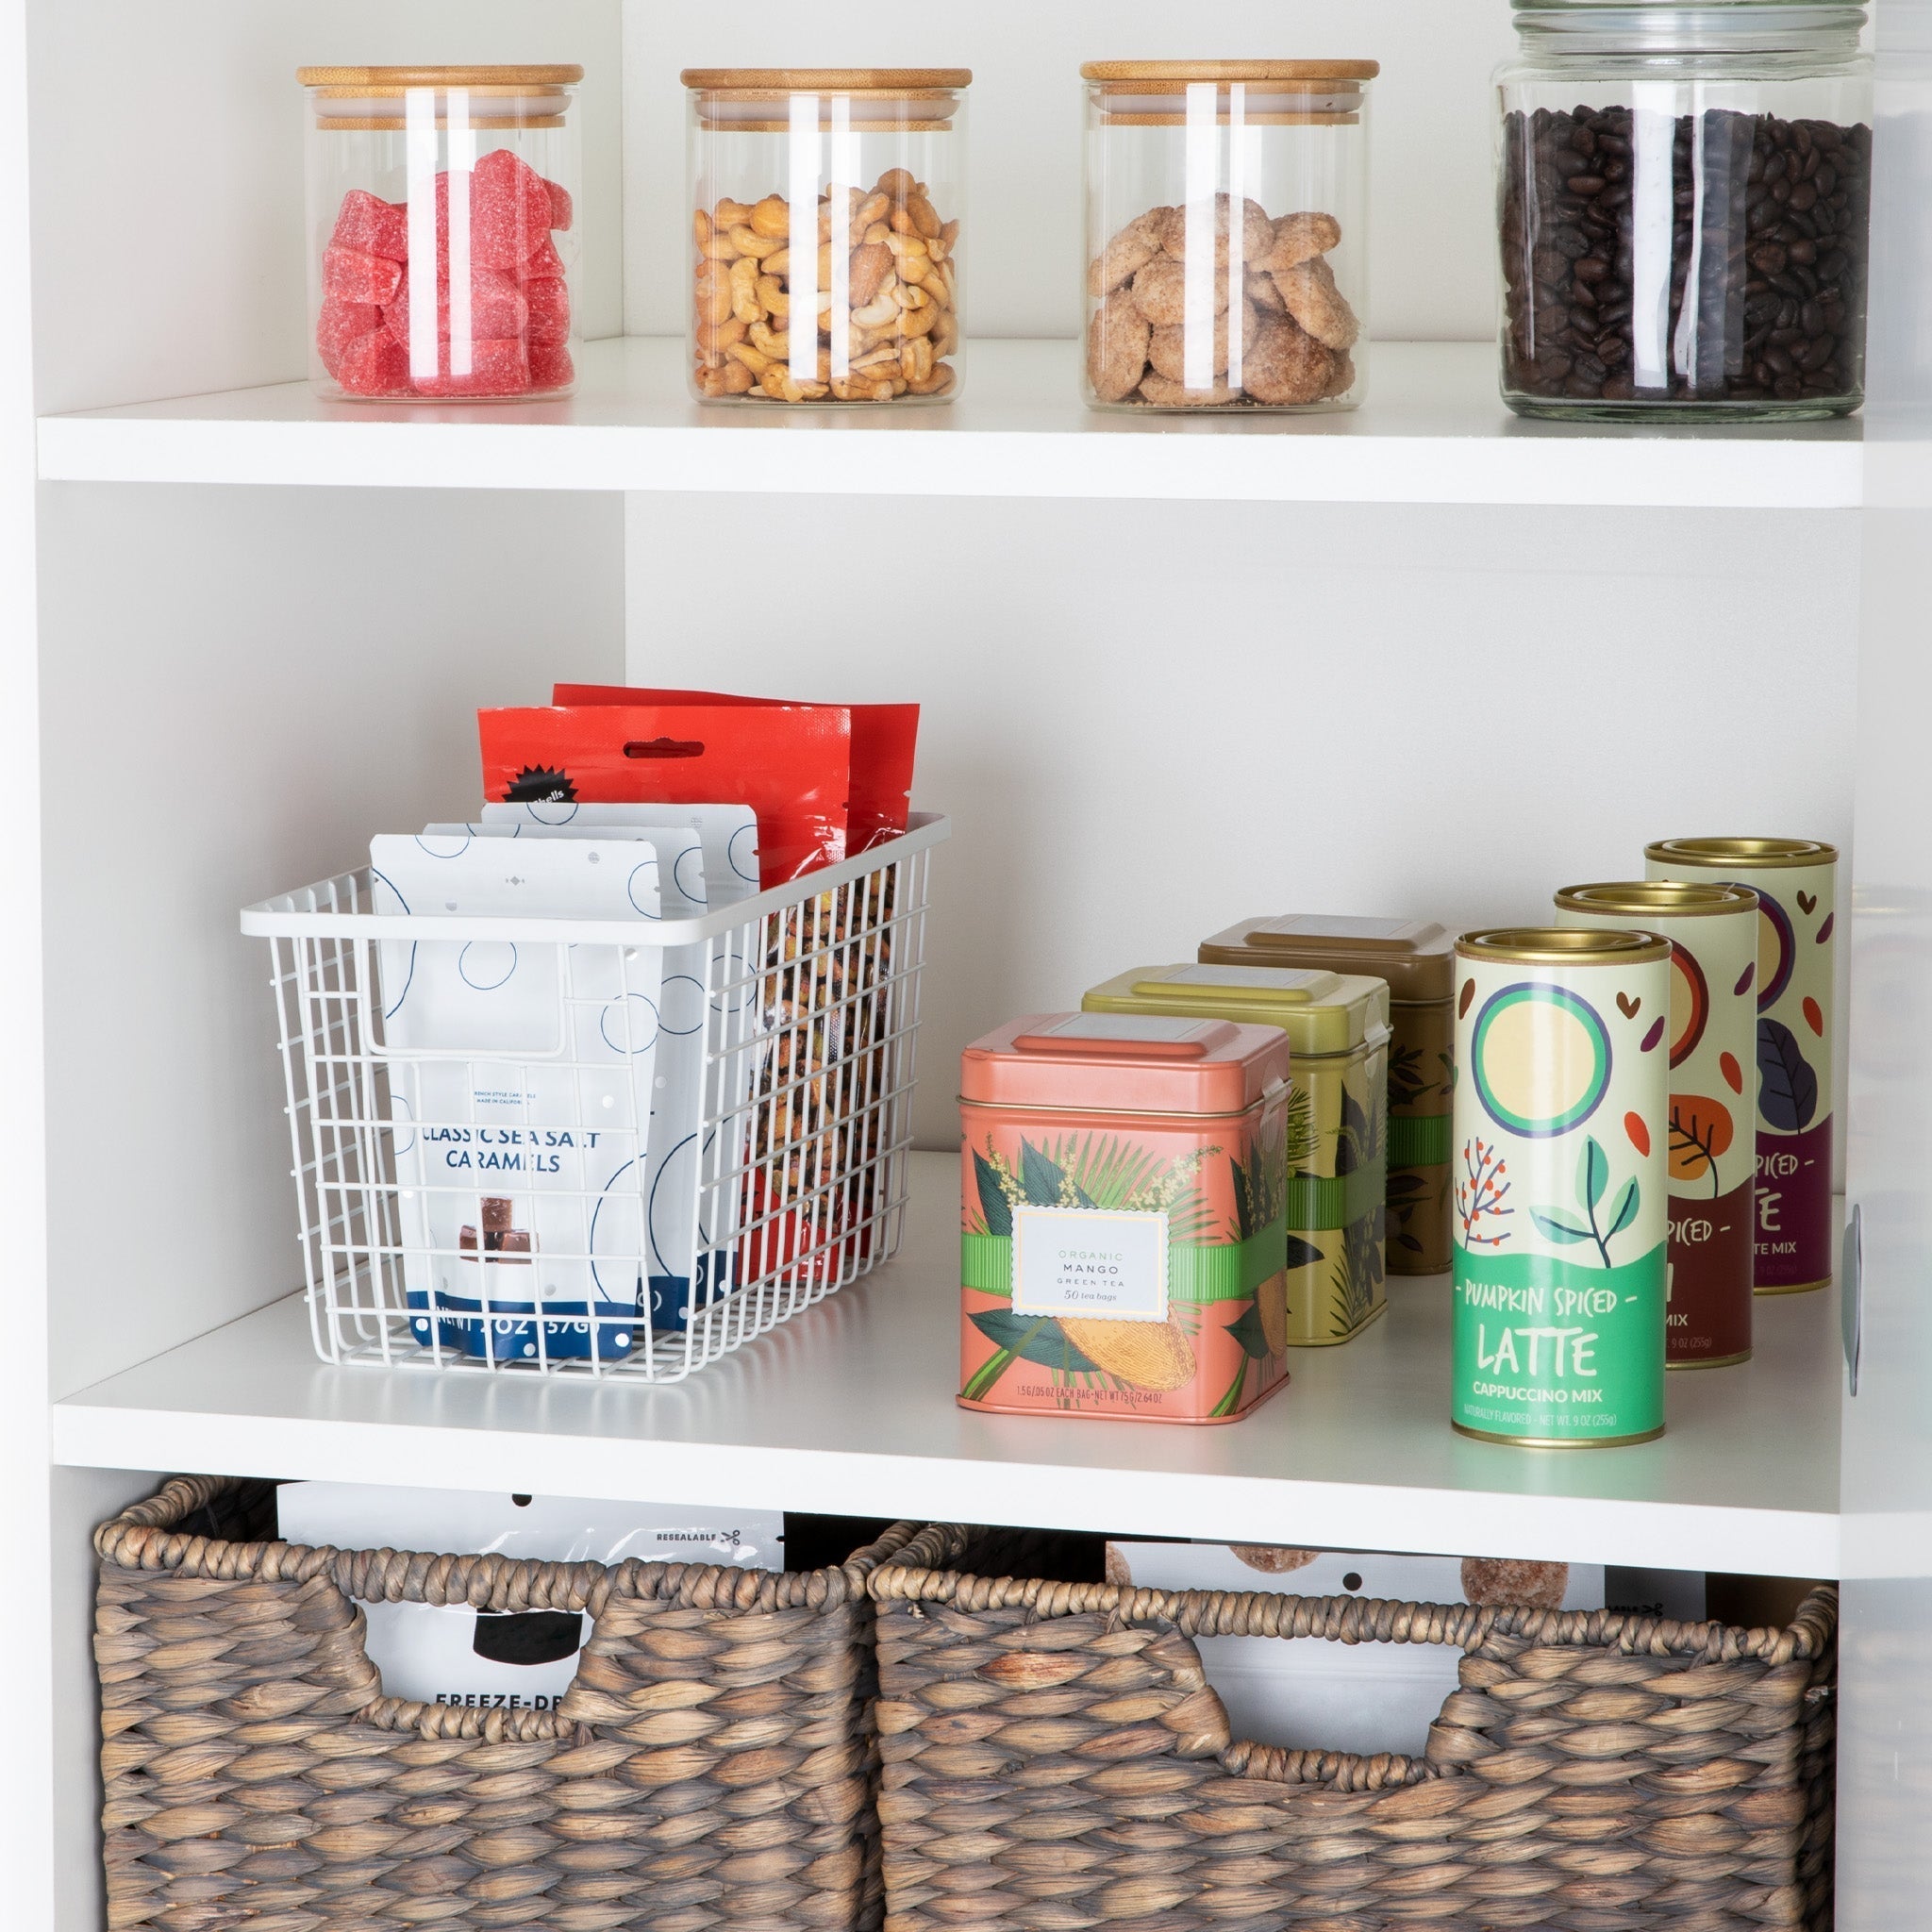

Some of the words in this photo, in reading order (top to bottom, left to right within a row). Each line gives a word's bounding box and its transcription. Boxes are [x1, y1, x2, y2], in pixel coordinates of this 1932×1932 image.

[545, 1131, 601, 1148] SAT
[446, 1150, 560, 1173] CARAMLS
[1772, 1241, 1797, 1254] MIX
[1058, 1250, 1124, 1261] ORGANIC
[1063, 1263, 1119, 1274] MANGO
[1057, 1277, 1096, 1286] GREEN
[1103, 1279, 1124, 1288] TEA
[1063, 1290, 1079, 1300] 50
[1096, 1292, 1118, 1302] bags
[1465, 1278, 1545, 1316] PUMPKIN
[1554, 1287, 1617, 1318] SPICED
[1477, 1324, 1599, 1377] LATTE
[1473, 1380, 1569, 1404] CAPPUCCINO
[1572, 1389, 1604, 1404] MIX
[1540, 1413, 1555, 1426] NET
[657, 1533, 716, 1541] RESEALABLE
